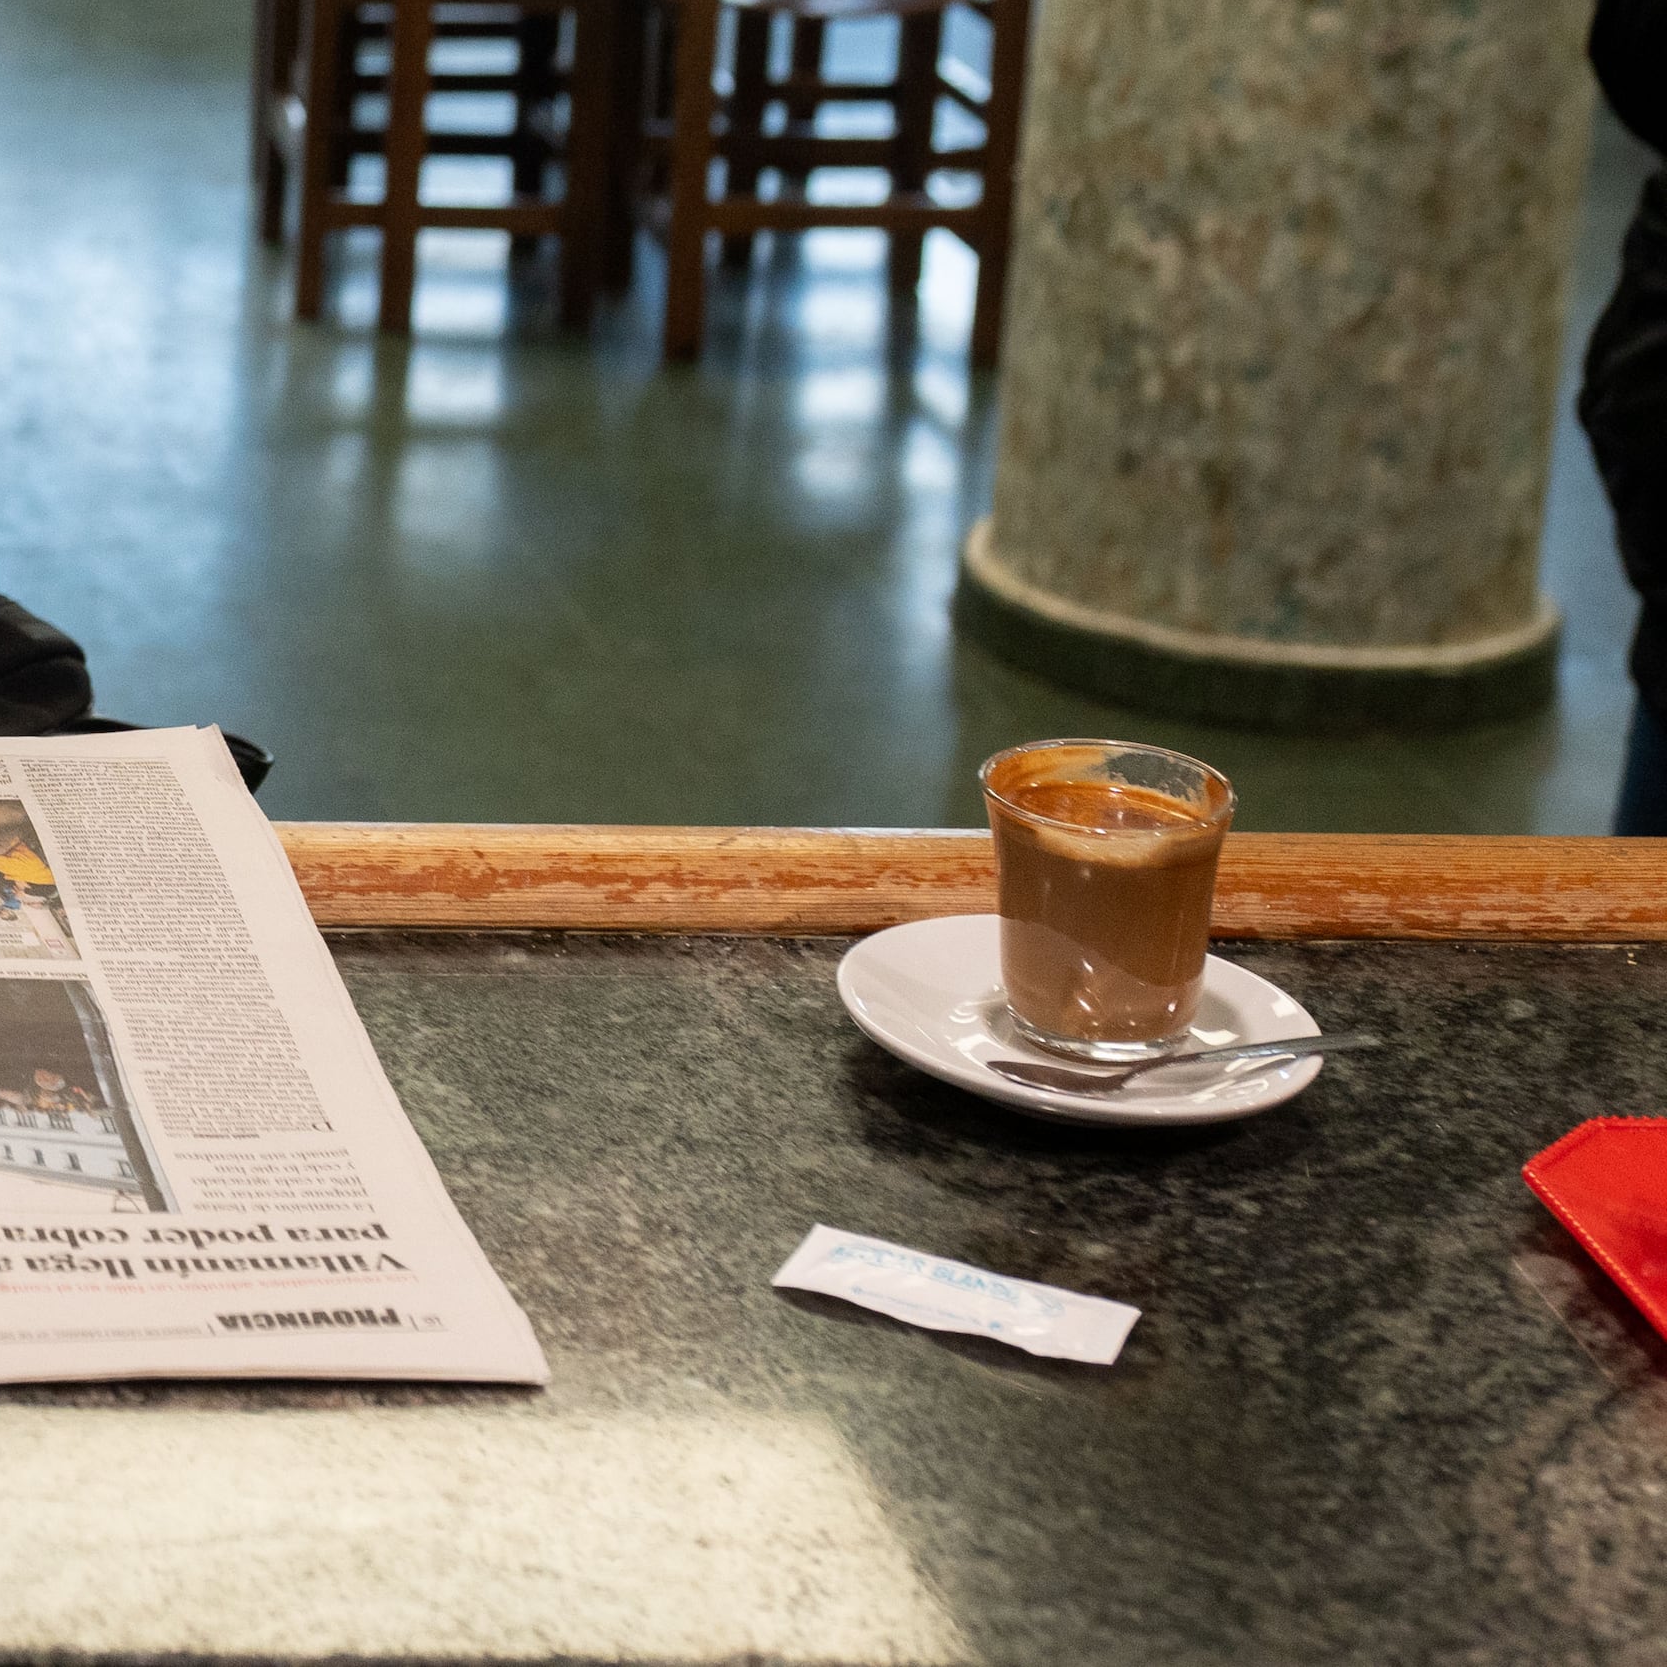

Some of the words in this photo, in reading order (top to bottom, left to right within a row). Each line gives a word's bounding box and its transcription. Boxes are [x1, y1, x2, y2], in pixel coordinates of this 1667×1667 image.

[142, 1223, 276, 1250] poder
[284, 1222, 390, 1243] para
[23, 1252, 137, 1280] llega
[143, 1254, 408, 1279] Villamanín
[214, 1306, 402, 1332] PROVINCIA
